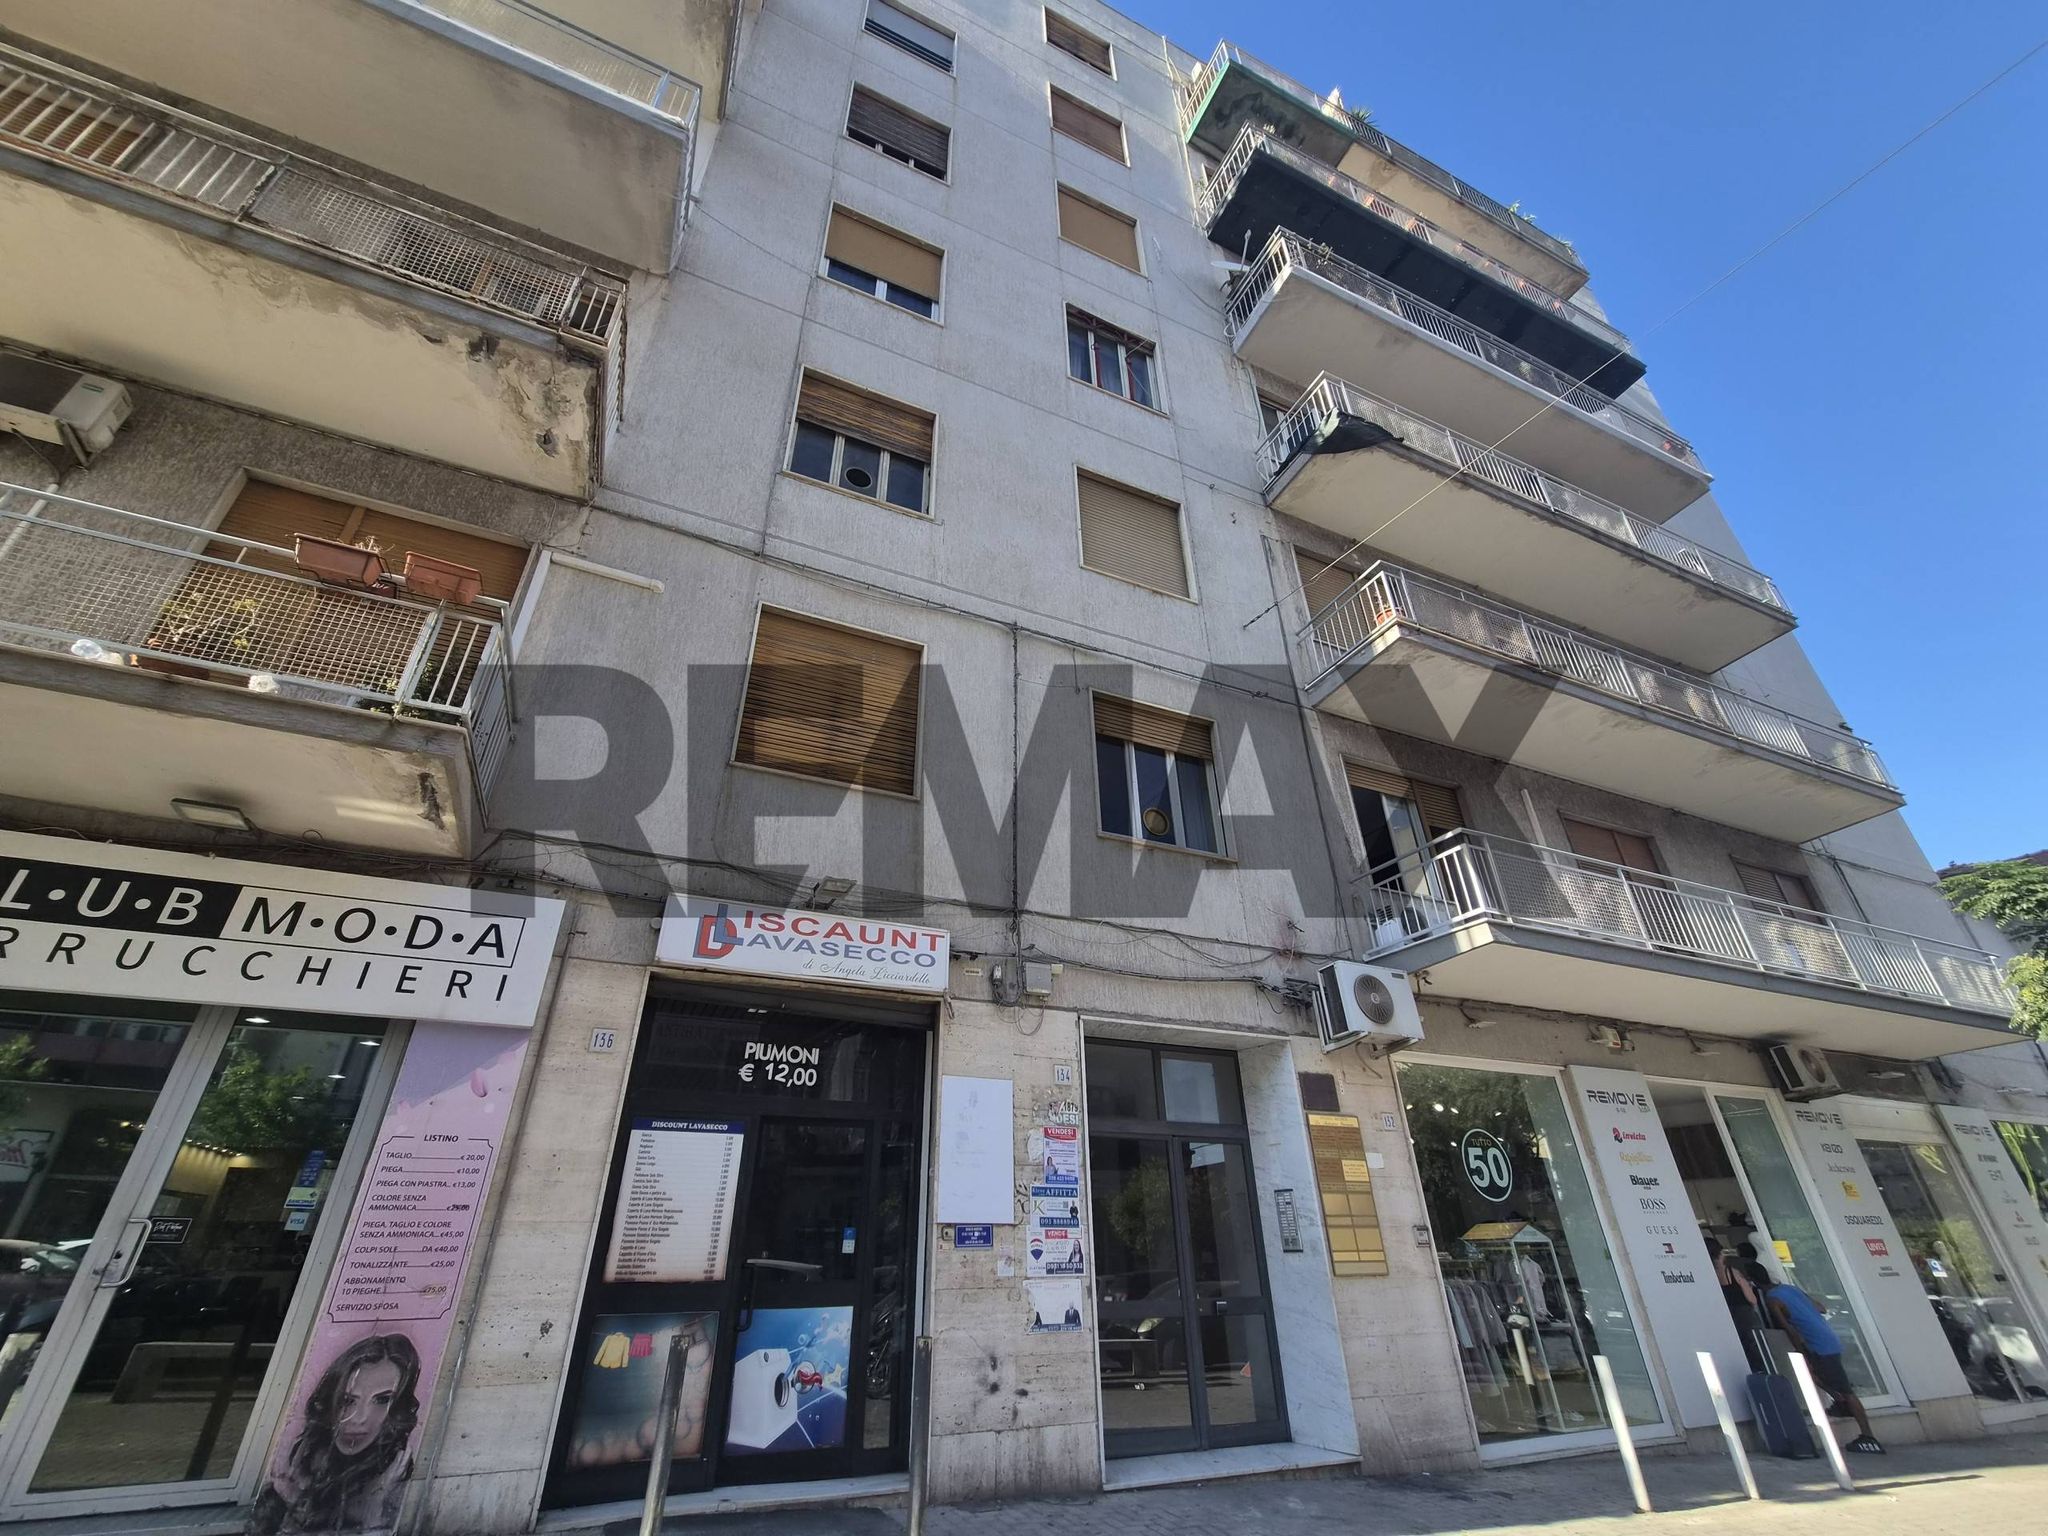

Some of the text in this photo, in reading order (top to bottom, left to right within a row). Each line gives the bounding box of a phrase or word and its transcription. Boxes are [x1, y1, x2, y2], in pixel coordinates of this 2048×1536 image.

[802, 958, 814, 969] di
[593, 1032, 615, 1049] 136
[744, 1042, 820, 1066] PIUMONI
[738, 1063, 818, 1088] € 12,00
[1056, 1068, 1070, 1082] 134
[1586, 1089, 1648, 1107] REMOVE
[1795, 1110, 1843, 1125] REMOVE
[652, 1121, 728, 1131] DISCOUNT LAVASECCO
[423, 1134, 459, 1143] LISTINO
[1467, 1147, 1509, 1188] 50
[1046, 1188, 1077, 1197] AFFITTA
[1639, 1198, 1667, 1210] BOSS
[1645, 1225, 1679, 1235] GUESS
[350, 1261, 408, 1269] TONALIZZANTE
[344, 1276, 406, 1285] ABBONAMENTO
[1661, 1271, 1695, 1283] Timberland
[351, 1287, 381, 1295] PIEGHE
[335, 1303, 372, 1312] SERVIZIO
